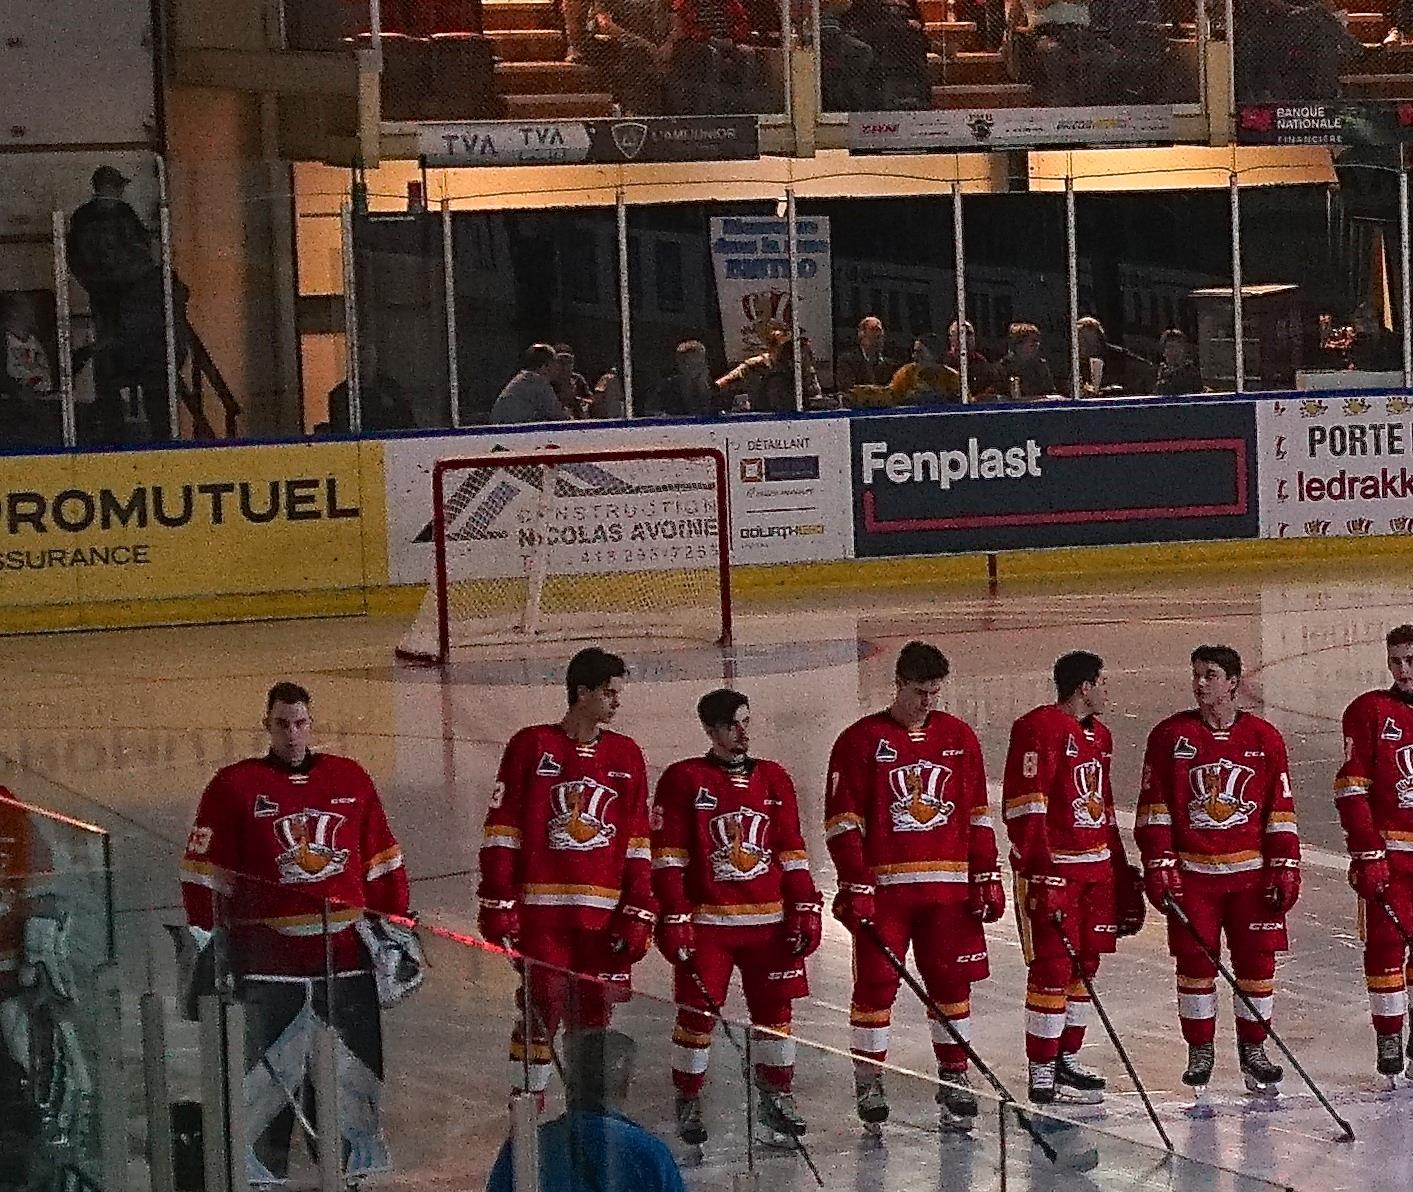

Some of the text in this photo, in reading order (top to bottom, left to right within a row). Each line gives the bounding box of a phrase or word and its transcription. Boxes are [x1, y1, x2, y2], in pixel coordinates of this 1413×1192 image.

[1277, 107, 1325, 118] BANQUE
[1277, 117, 1342, 129] NATIONALE
[441, 134, 498, 156] TVA
[518, 127, 565, 146] TVA
[1309, 421, 1404, 457] PORTE
[861, 437, 1042, 490] Fenplast
[0, 476, 361, 535] ROMUTUEL
[0, 543, 152, 571] SURANCE
[1093, 923, 1120, 934] CC
